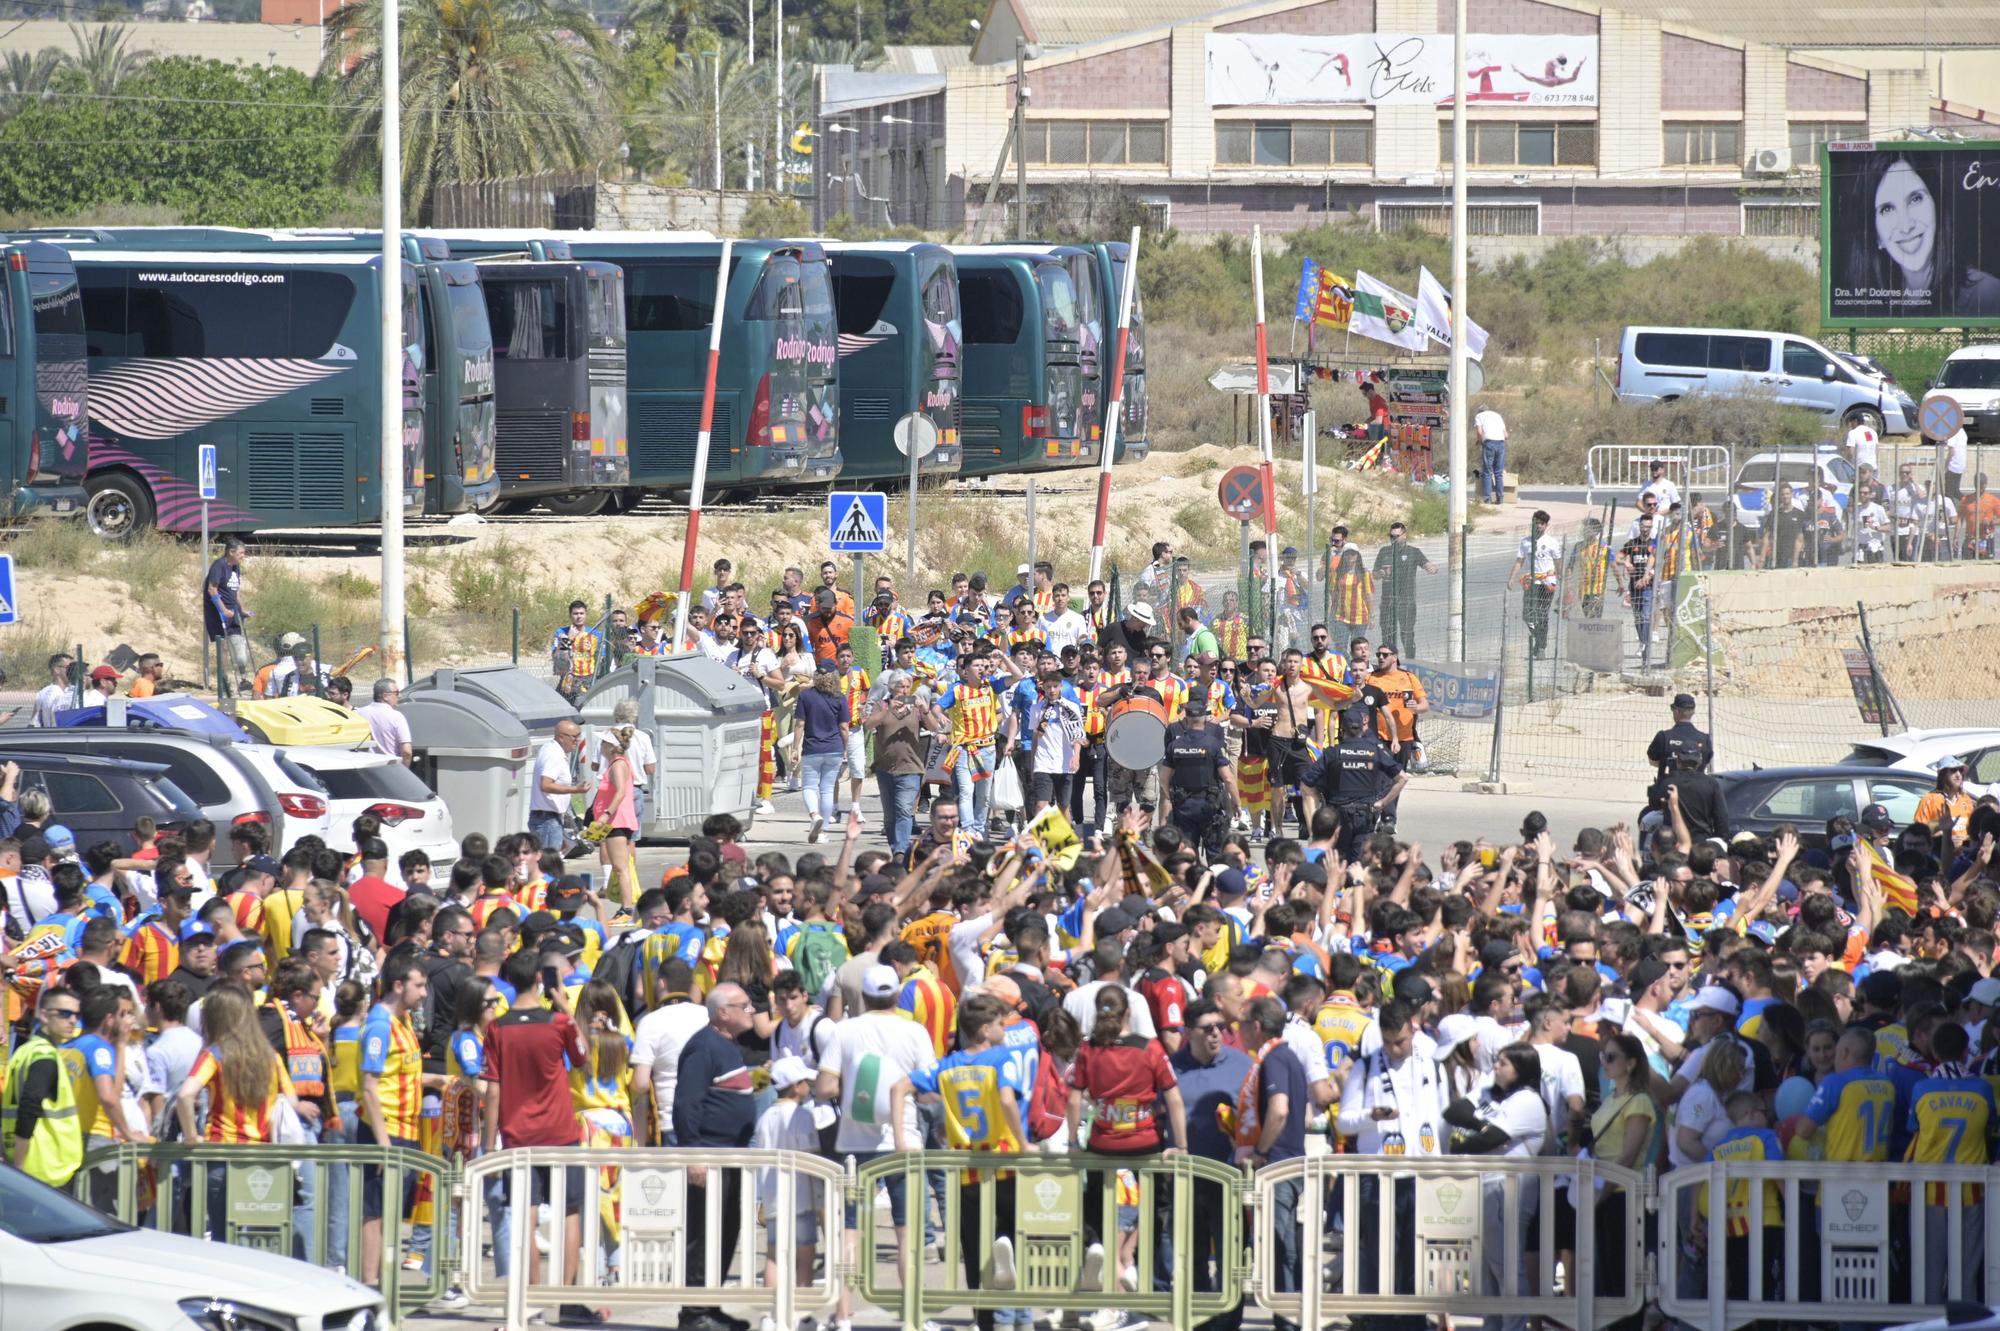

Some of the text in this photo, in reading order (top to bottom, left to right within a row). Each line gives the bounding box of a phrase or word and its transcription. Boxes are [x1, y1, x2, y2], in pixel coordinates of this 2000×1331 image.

[1544, 94, 1560, 102] 673
[1561, 94, 1577, 102] 778
[1962, 161, 1998, 190] En
[138, 272, 284, 286] www.autocaresrodrigo.com
[1834, 288, 1853, 296] Dra.
[1869, 288, 1901, 296] Dolores
[1426, 323, 1452, 344] VALEN
[776, 334, 805, 364] Rodrigo
[807, 340, 835, 368] Rodrigo
[52, 397, 79, 419] Rodrigo
[1253, 708, 1278, 716] TOY
[1929, 1096, 1977, 1112] CAVANI
[957, 1089, 990, 1142] 5
[1857, 1100, 1893, 1153] 14
[1939, 1117, 1967, 1163] 7
